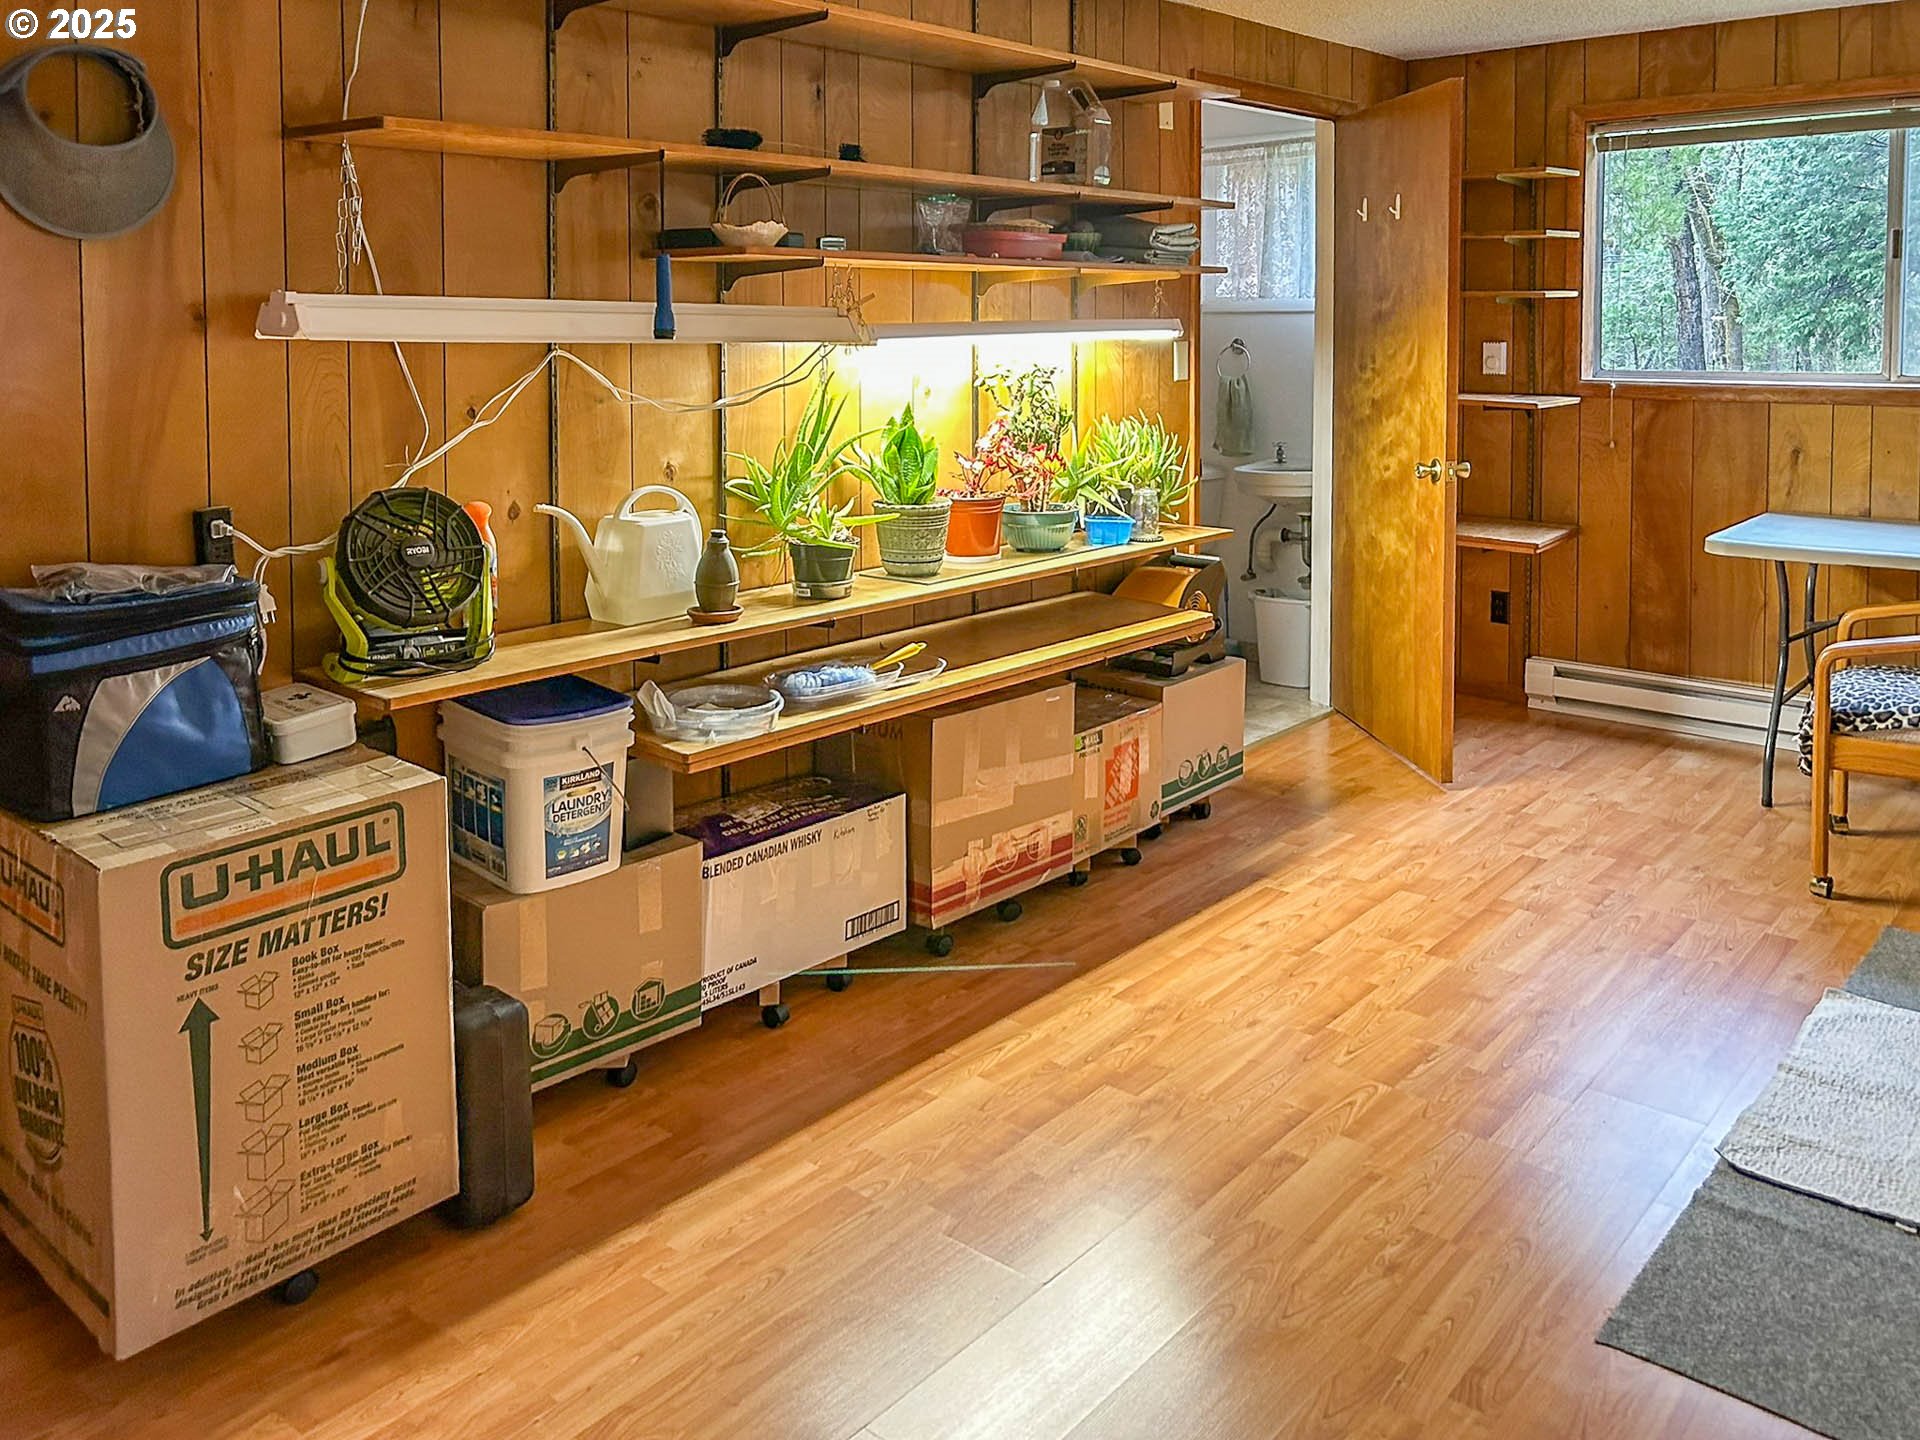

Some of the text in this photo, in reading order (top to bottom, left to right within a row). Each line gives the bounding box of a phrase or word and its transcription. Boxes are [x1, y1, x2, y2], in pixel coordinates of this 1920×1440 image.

[406, 546, 430, 556] RYOBI
[561, 769, 601, 785] KIRKLAND
[552, 789, 609, 815] LAUNDRY
[553, 802, 606, 824] DETERGENT
[180, 820, 391, 911] U-HAUL
[702, 828, 823, 880] BLENDED CANADIAN WHISKY
[184, 891, 389, 981] SIZE MATTERS!
[292, 943, 340, 968] Book Box
[726, 965, 734, 976] OF
[734, 956, 758, 972] CANADA
[707, 976, 727, 989] PROOF
[709, 982, 728, 996] LITERS
[294, 995, 345, 1021] Small Box
[14, 1031, 53, 1083] 100%
[297, 1043, 359, 1075] Medium Box
[298, 1101, 349, 1129] Large Box
[300, 1149, 359, 1181] Extra-Large
[360, 1139, 379, 1155] Box
[175, 1287, 185, 1300] In
[188, 1267, 232, 1292] addition,
[317, 1215, 338, 1231] than
[352, 1189, 392, 1215] specialty
[240, 1262, 262, 1281] your
[355, 1201, 388, 1223] storage
